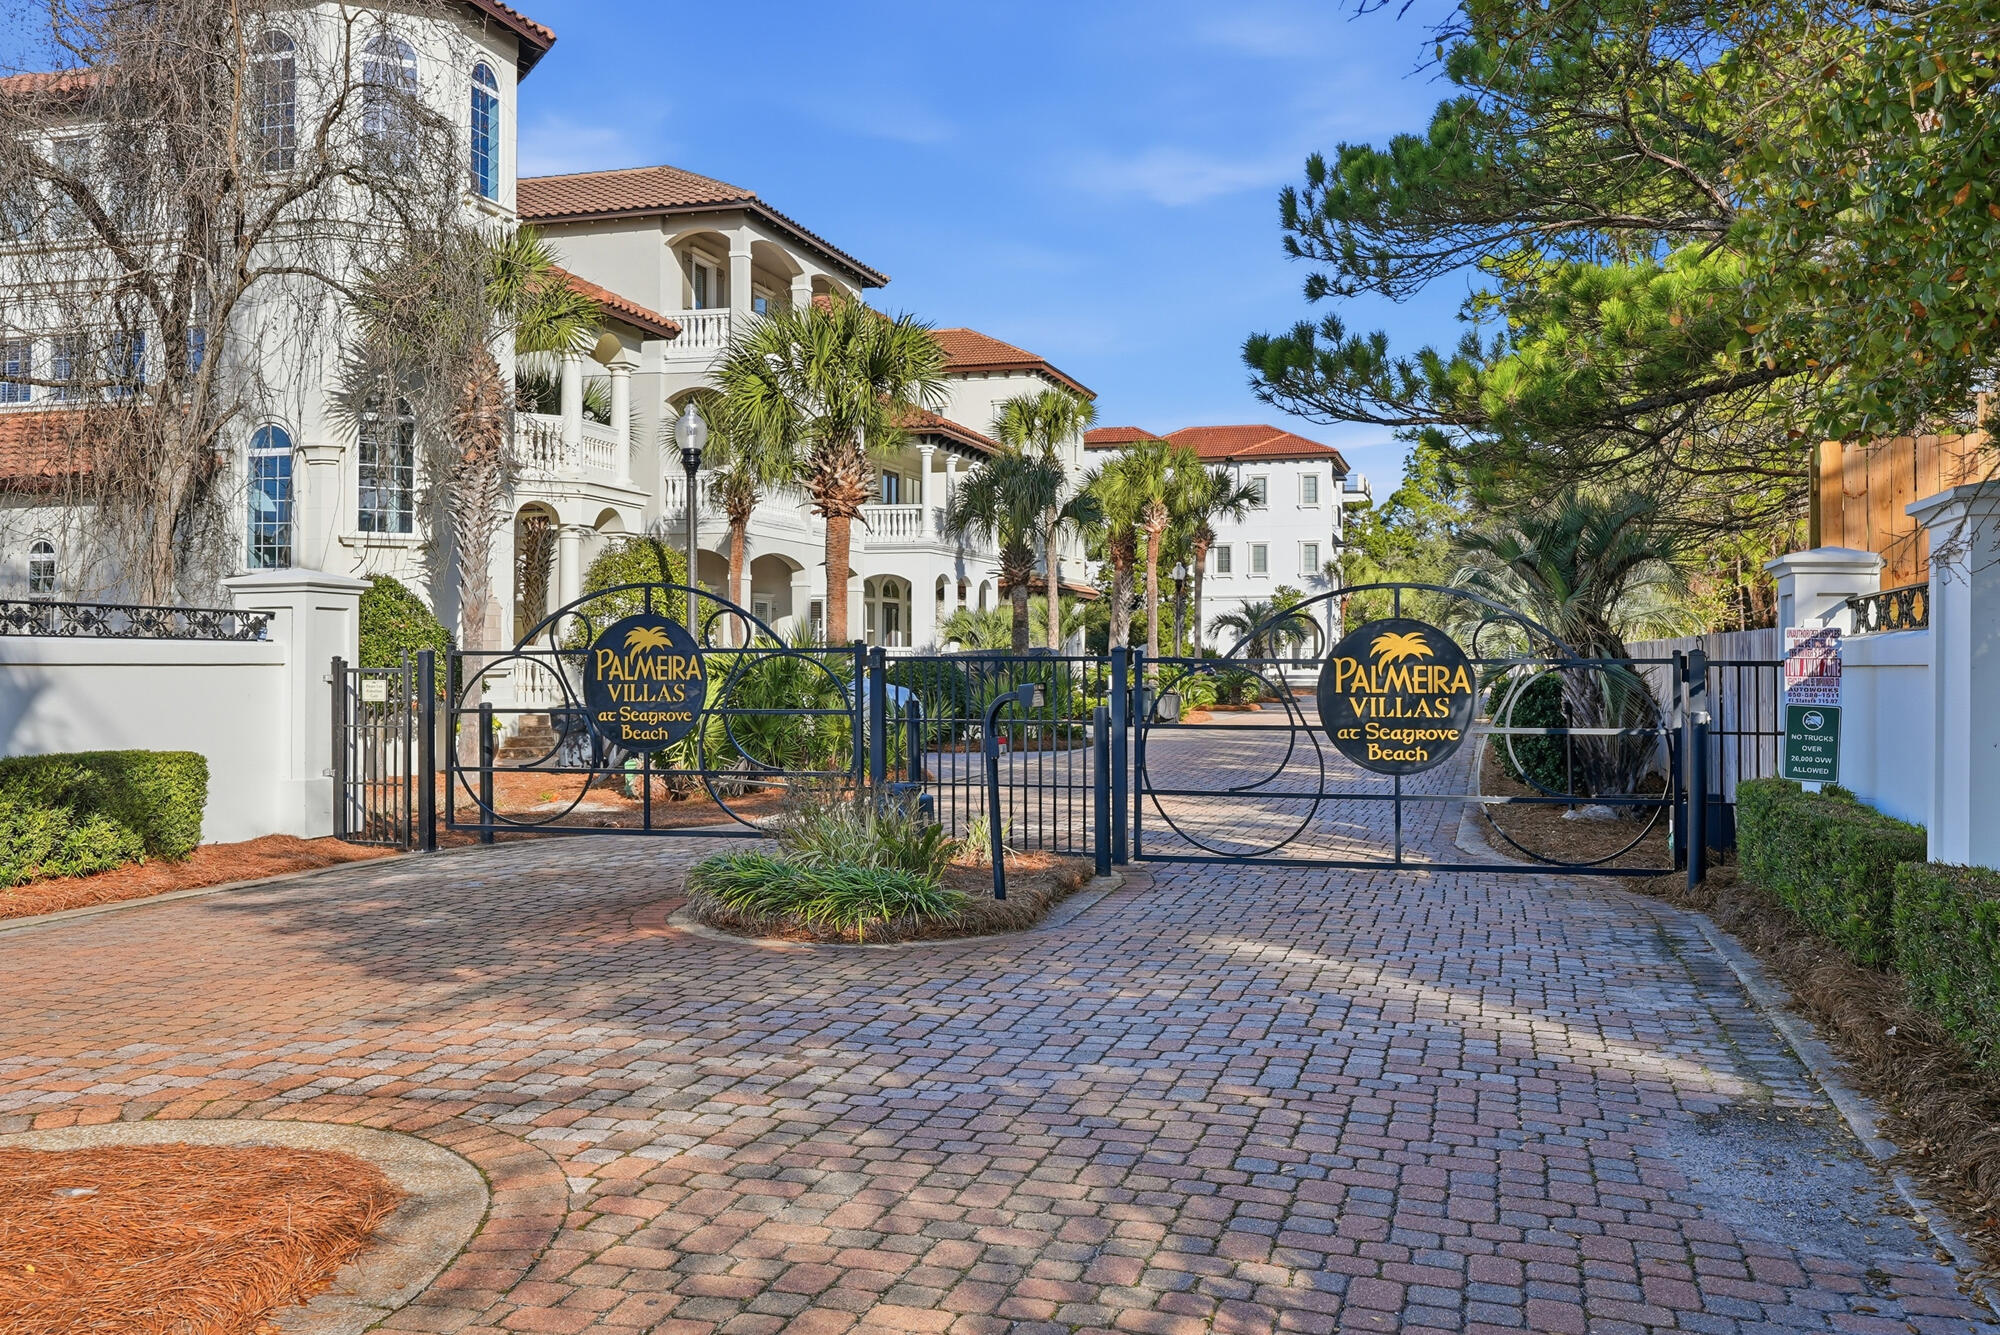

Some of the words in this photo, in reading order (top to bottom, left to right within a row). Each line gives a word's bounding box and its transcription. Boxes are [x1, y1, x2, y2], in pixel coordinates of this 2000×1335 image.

[595, 648, 702, 681] PALMEIRA
[1786, 659, 1801, 677] TOW
[1802, 659, 1821, 677] AWAY
[1823, 659, 1841, 677] ZONE
[1333, 657, 1472, 694] PALMEIRA
[607, 683, 685, 702] VILLAS
[597, 711, 617, 722] at
[619, 706, 693, 725] Seagrove
[1349, 697, 1450, 718] VILLAS
[620, 724, 669, 740] Beach
[1337, 728, 1361, 740] at
[1364, 723, 1460, 745] Seagrove
[1804, 734, 1834, 742] TRUCKS
[1367, 743, 1428, 761] Beach
[1792, 766, 1829, 774] ALLOWED
